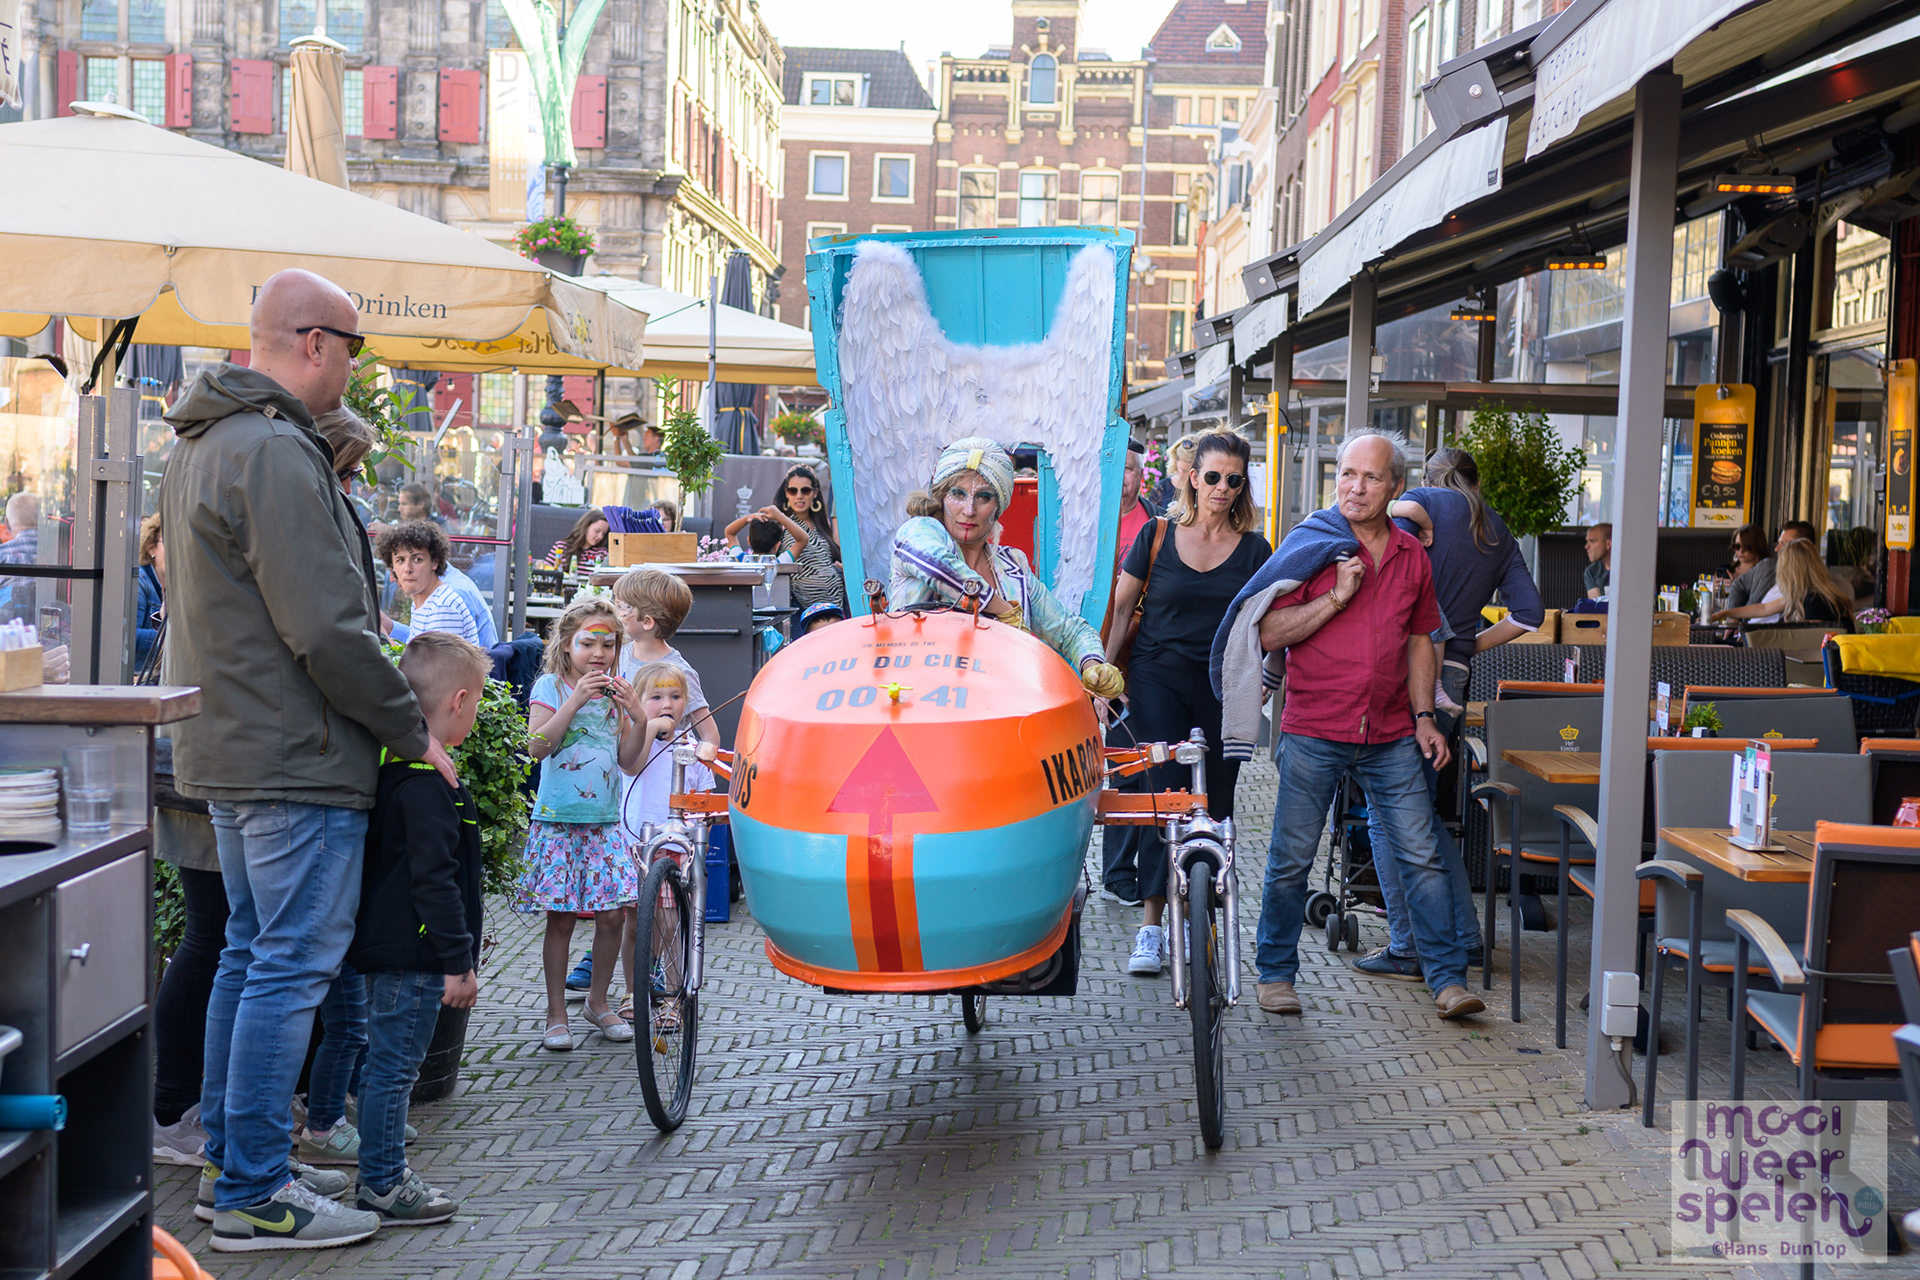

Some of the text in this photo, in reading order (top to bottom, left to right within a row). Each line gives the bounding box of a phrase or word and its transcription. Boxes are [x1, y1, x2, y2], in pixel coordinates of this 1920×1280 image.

[1704, 438, 1738, 447] Pannen
[1711, 446, 1743, 455] koeken
[802, 654, 986, 680] POU DU CIEL
[816, 685, 968, 711] 00 41
[1041, 735, 1101, 805] IKAROS
